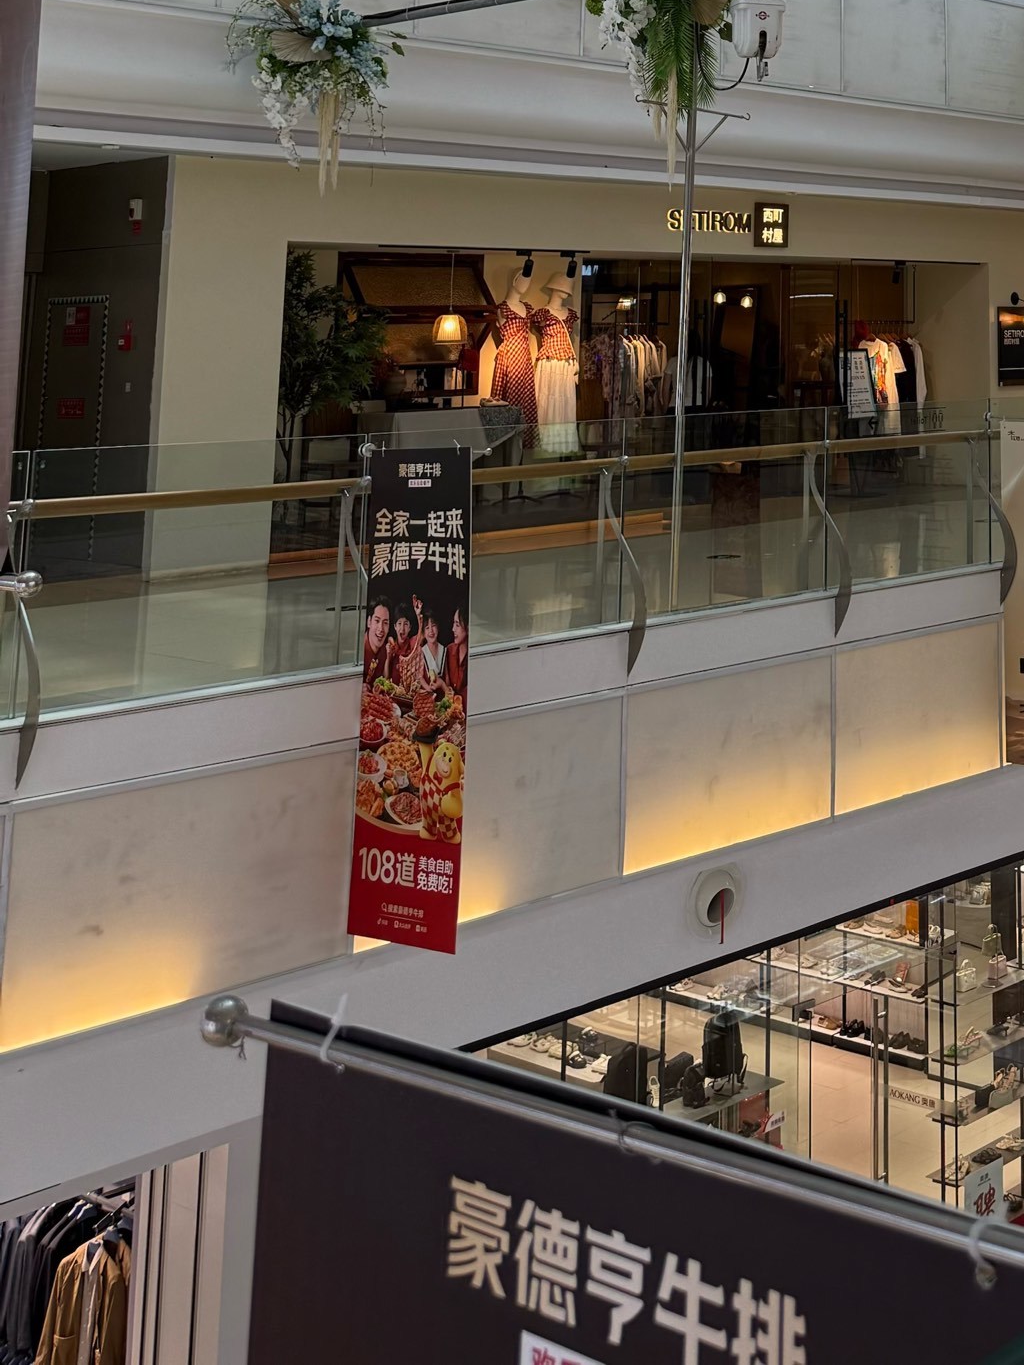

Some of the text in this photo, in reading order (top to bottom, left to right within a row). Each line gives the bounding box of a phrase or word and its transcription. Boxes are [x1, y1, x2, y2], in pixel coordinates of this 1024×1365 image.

[667, 208, 752, 234] STIROM
[398, 462, 442, 478] 豪德亨牛排
[374, 507, 465, 539] 全家一起来
[371, 541, 467, 581] 豪德亨牛排
[359, 846, 417, 888] 108道
[418, 855, 454, 876] 美食自助
[416, 872, 454, 895] 免费吃!
[889, 1088, 921, 1105] AOKANG
[446, 1174, 808, 1365] 豪德亨牛排
